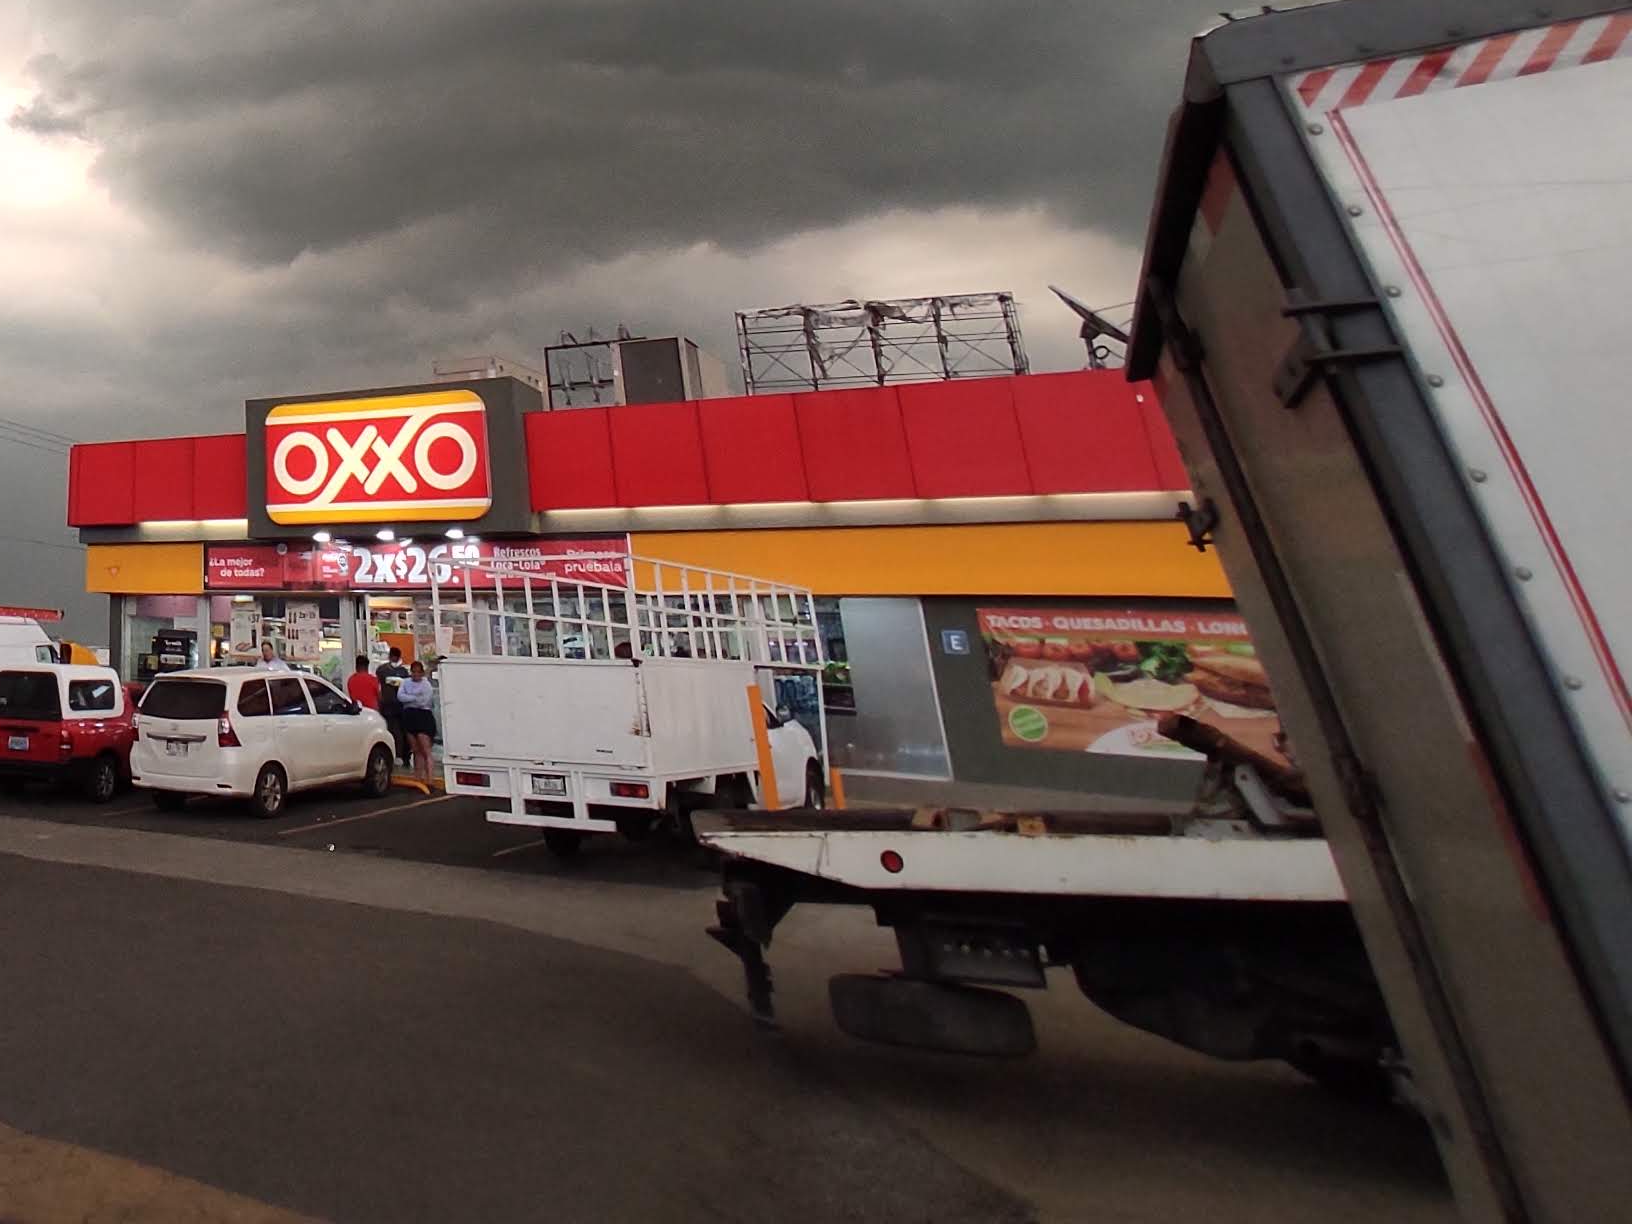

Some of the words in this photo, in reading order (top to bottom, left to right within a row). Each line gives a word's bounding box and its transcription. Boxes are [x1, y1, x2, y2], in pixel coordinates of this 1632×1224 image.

[274, 413, 478, 502] OXXO
[226, 557, 253, 568] mejor
[220, 567, 233, 577] de
[234, 567, 265, 578] todas?
[985, 614, 1043, 629] TACOS
[1052, 615, 1187, 634] QUESADILLAS
[950, 634, 963, 650] E
